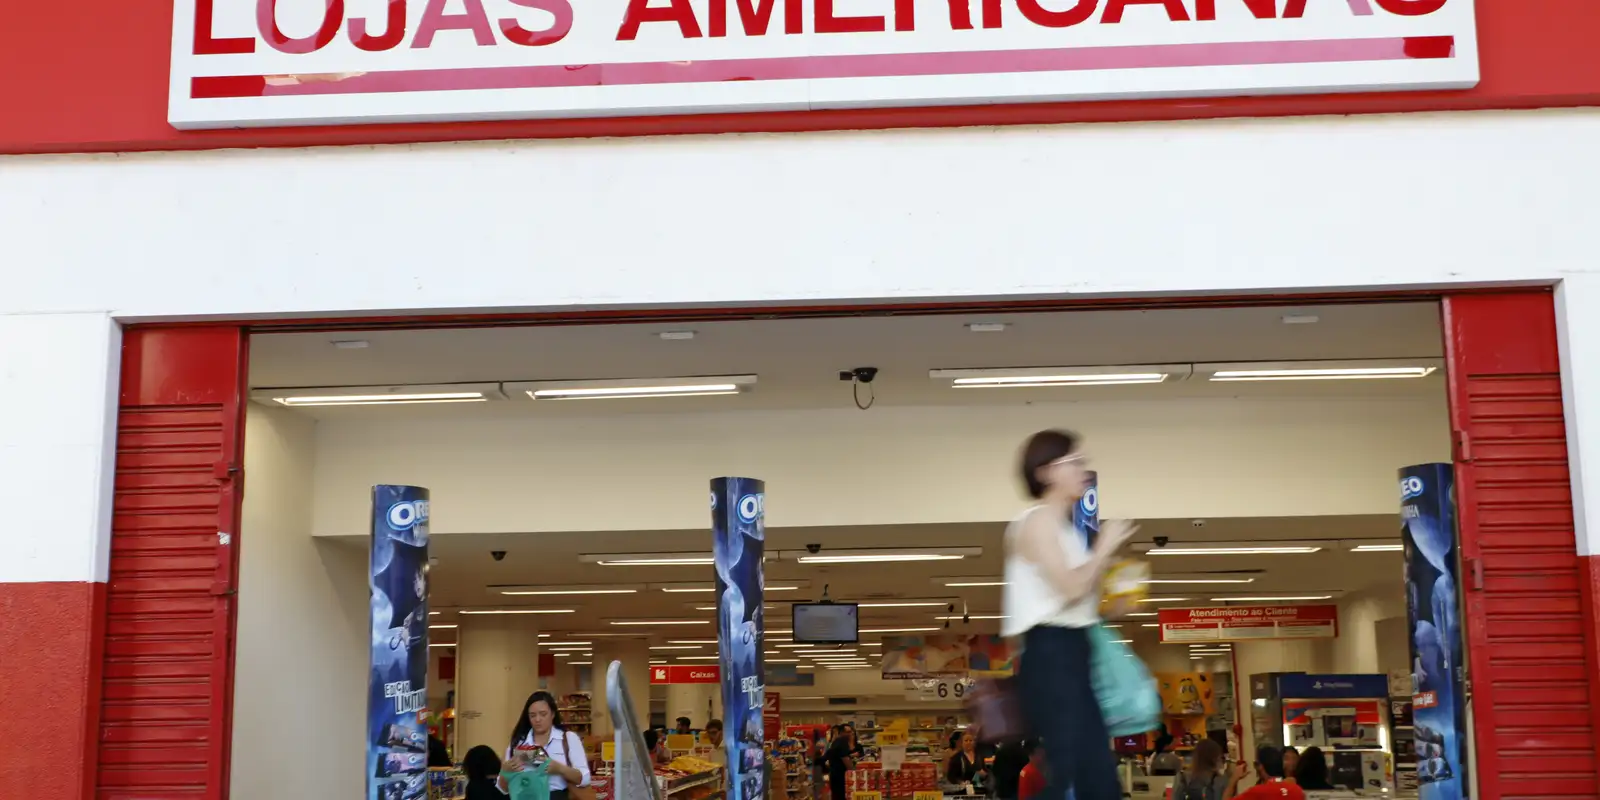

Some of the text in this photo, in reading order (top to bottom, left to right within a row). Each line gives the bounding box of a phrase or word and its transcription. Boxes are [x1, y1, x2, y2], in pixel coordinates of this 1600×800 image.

[1189, 607, 1298, 617] Atendimento ao Cliente
[690, 671, 716, 679] Caixas
